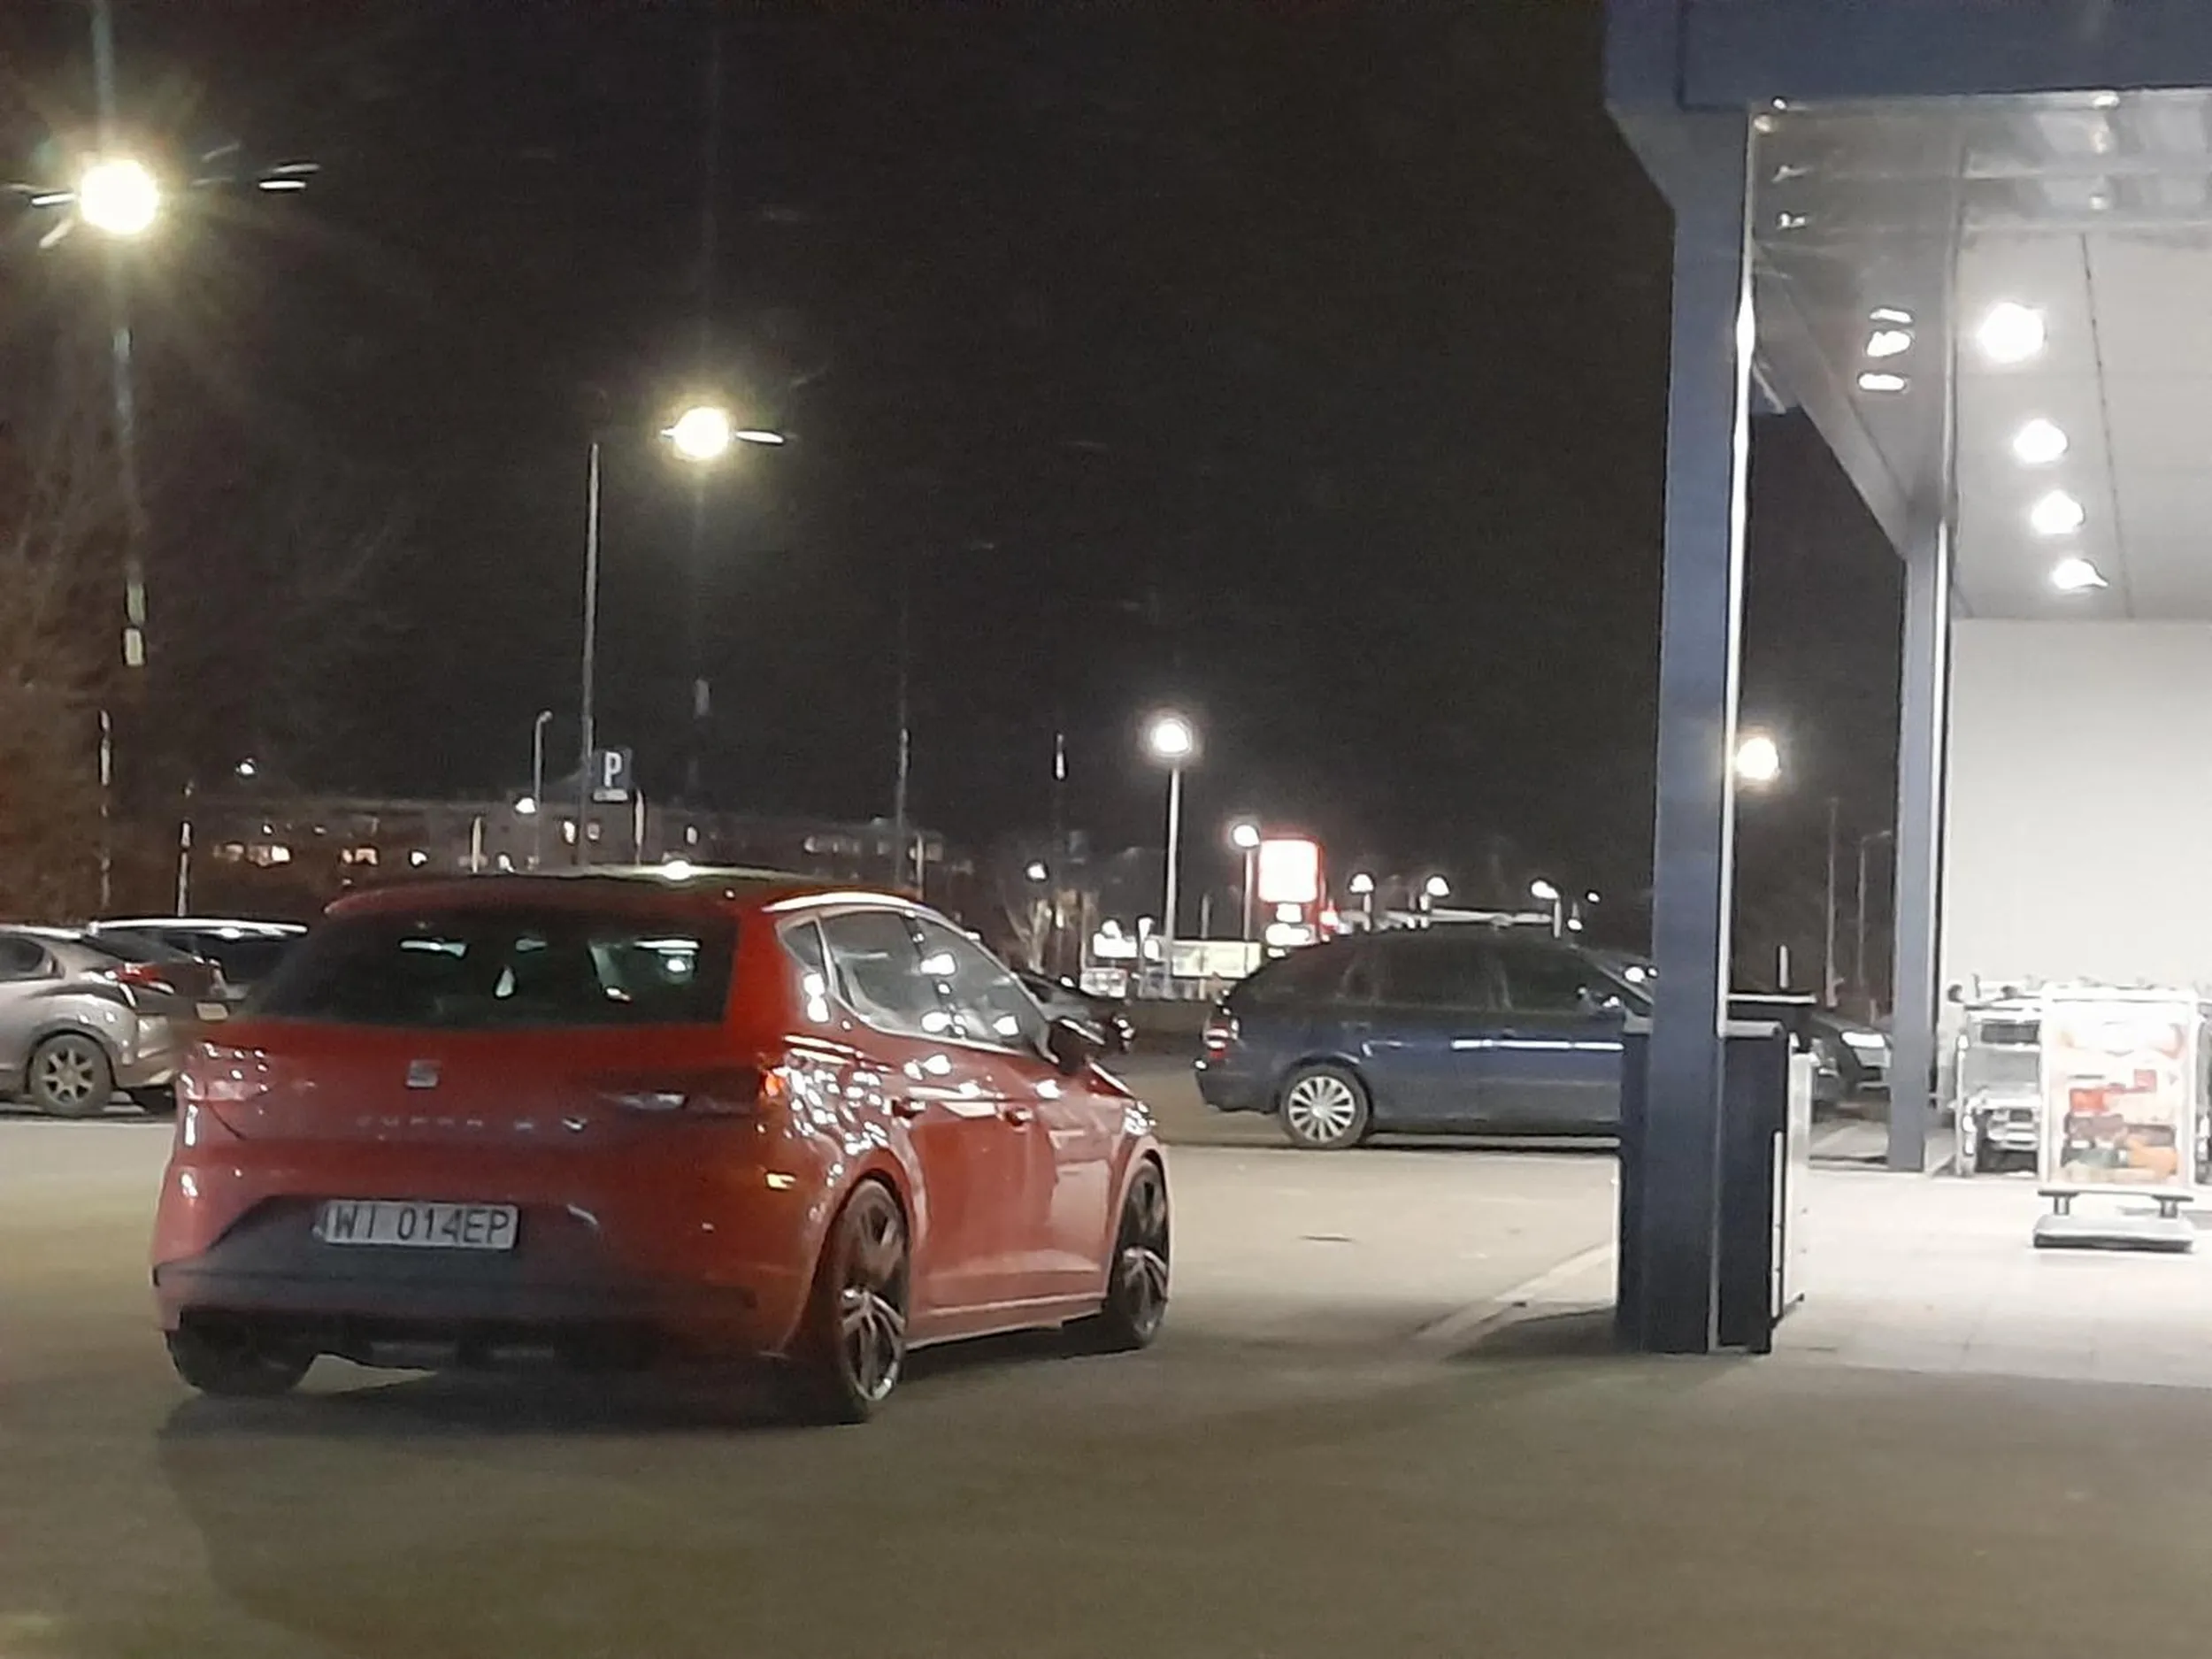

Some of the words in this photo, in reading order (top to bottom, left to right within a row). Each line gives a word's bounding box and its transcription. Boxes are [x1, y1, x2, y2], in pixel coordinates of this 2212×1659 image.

[604, 751, 622, 787] P
[334, 1203, 376, 1240] WI
[397, 1207, 510, 1243] 014EP
